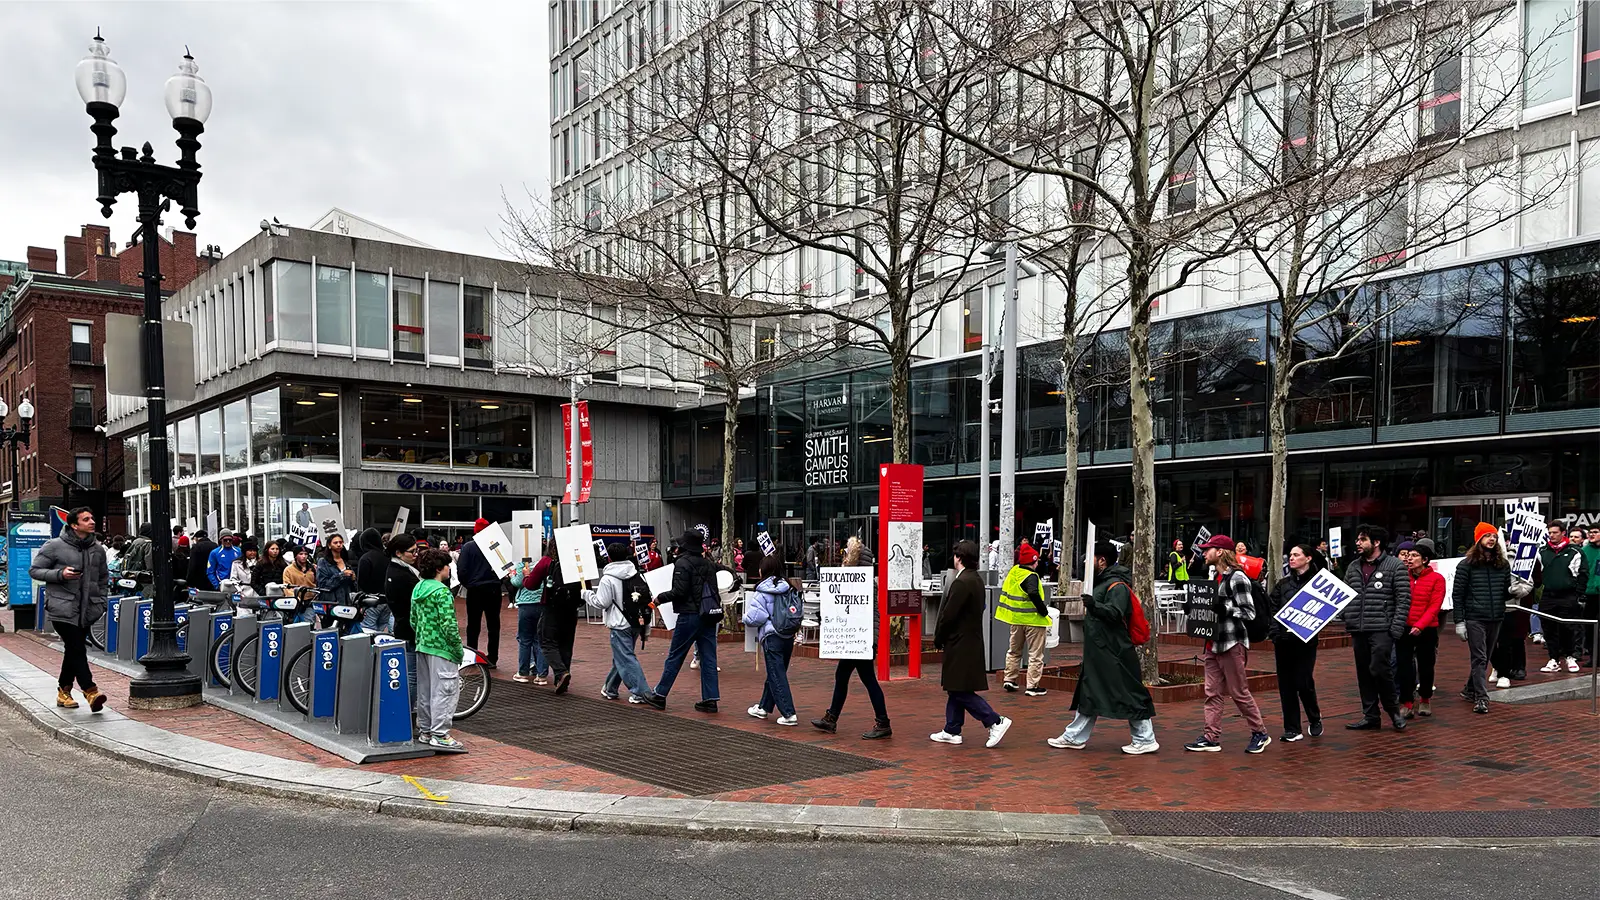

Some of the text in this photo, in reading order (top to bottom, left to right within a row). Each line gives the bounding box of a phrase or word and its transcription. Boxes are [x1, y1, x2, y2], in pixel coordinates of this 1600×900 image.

[813, 397, 846, 409] HARVAR
[805, 435, 849, 457] SMITH
[805, 455, 849, 472] CAMPUS
[805, 470, 848, 486] CENTER
[416, 478, 508, 493] Eastern Bank
[1507, 502, 1536, 515] UAW
[292, 525, 305, 538] UAW
[1037, 525, 1052, 533] UAW
[1523, 524, 1543, 542] UAW
[1513, 559, 1534, 572] STRIKE
[821, 573, 866, 583] EDUCATORS
[829, 584, 841, 594] ON
[1189, 584, 1197, 594] WE
[1312, 575, 1349, 606] UAW
[835, 595, 869, 605] STRIKE!
[845, 605, 850, 615] 4
[1302, 600, 1325, 615] ON
[836, 616, 848, 627] Pay
[1188, 609, 1218, 623] AY EQUITY
[1280, 607, 1324, 631] STRIKE
[1194, 627, 1213, 637] NOW
